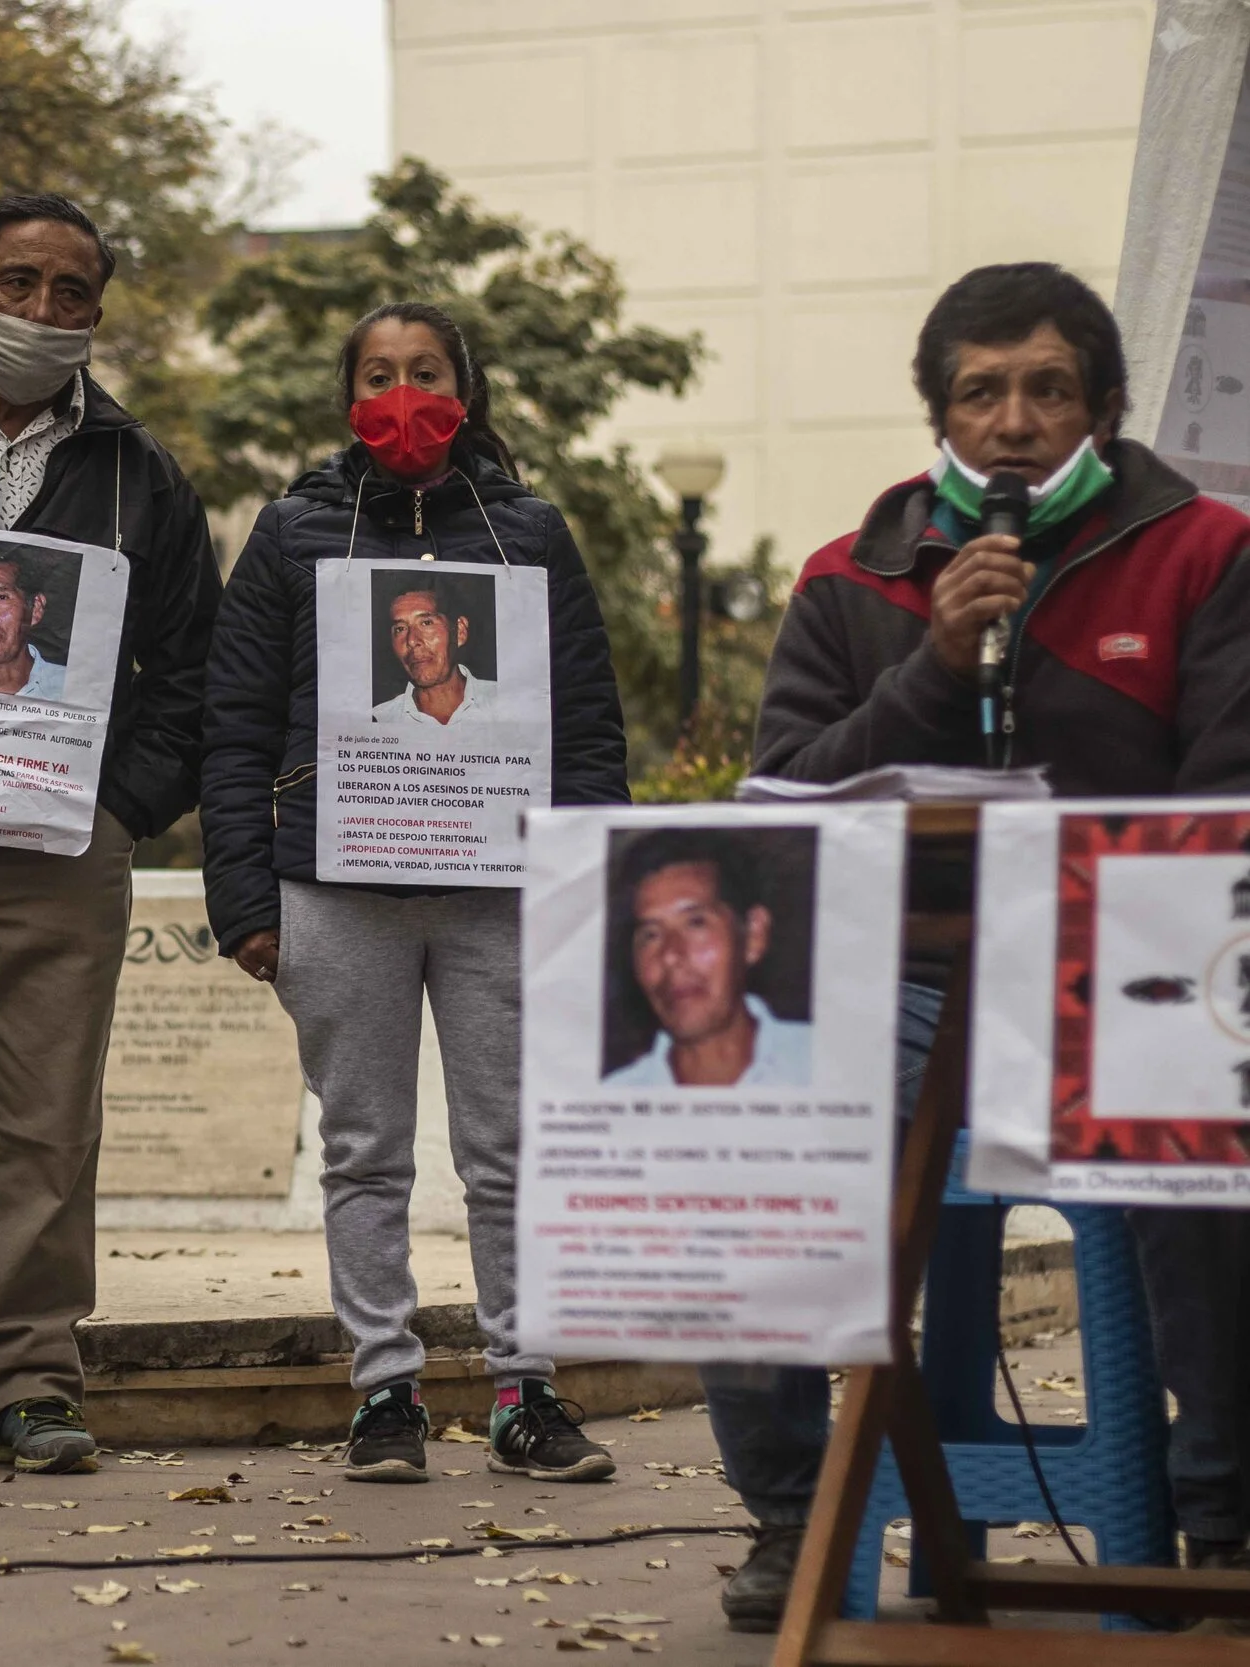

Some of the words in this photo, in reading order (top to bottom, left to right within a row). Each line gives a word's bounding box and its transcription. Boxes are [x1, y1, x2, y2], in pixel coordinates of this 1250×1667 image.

[21, 705, 41, 715] PARA
[44, 709, 59, 717] LOS
[12, 730, 46, 741] NUESTRA
[49, 735, 92, 748] AUTORIDAD
[354, 735, 369, 743] julio
[381, 736, 399, 744] 2020
[338, 750, 350, 758] EN
[355, 750, 411, 761] ARGENTINA
[416, 752, 431, 761] NO
[436, 753, 455, 762] HAY
[459, 754, 500, 764] JUSTICIA
[505, 756, 531, 765] PARA
[16, 757, 49, 771] FIRME
[50, 762, 69, 774] YA!
[337, 763, 355, 772] LOS
[358, 764, 400, 774] PUEBLOS
[402, 765, 465, 776] ORIGINARIOS
[15, 771, 35, 781] PARA
[35, 775, 49, 784] LOS
[337, 781, 390, 791] LIBERARON
[393, 783, 400, 791] A
[402, 783, 420, 792] LOS
[422, 784, 468, 794] ASESINOS
[471, 786, 483, 794] DE
[486, 786, 530, 796] NUESTRA
[337, 794, 394, 805] AUTORIDAD
[396, 796, 428, 806] JAVIER
[430, 798, 484, 808] CHOCOBAR
[343, 816, 374, 825] ¡JAVIER
[376, 818, 424, 827] CHOCOBAR
[427, 820, 471, 829] PRESENTE!
[343, 830, 373, 839] ¡BASTA
[375, 831, 386, 839] DE
[389, 832, 427, 841] DESPOJO
[429, 833, 486, 843] TERRITORIAL!
[342, 844, 395, 854] ¡PROPIEDAD
[397, 846, 459, 856] COMUNITARIA
[461, 849, 476, 857] YA!
[342, 858, 392, 869] ¡MEMORIA,
[393, 860, 431, 871] VERDAD,
[433, 862, 470, 871] JUSTICIA
[472, 863, 478, 871] Y
